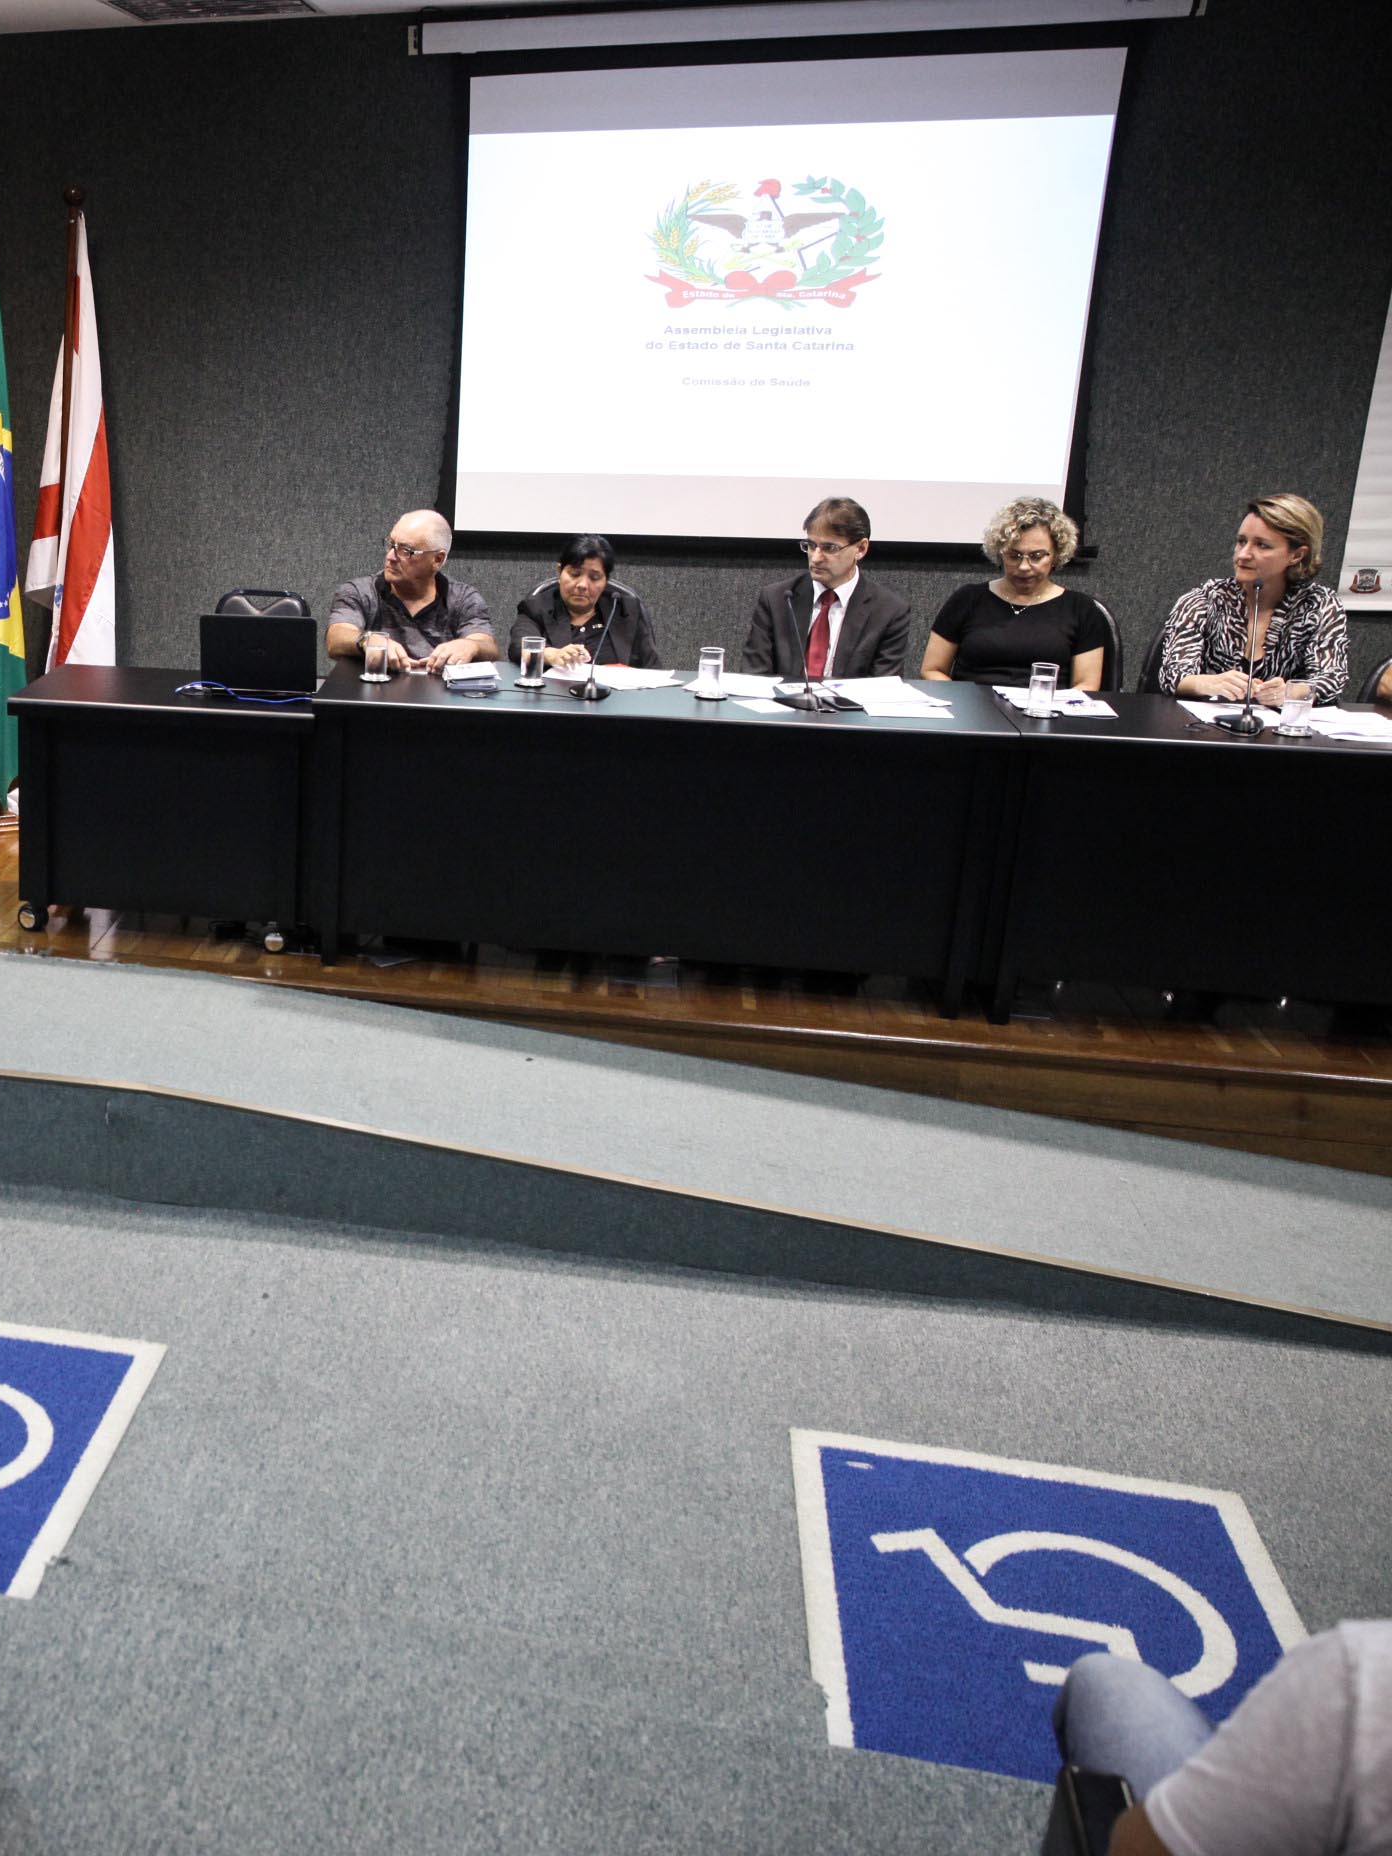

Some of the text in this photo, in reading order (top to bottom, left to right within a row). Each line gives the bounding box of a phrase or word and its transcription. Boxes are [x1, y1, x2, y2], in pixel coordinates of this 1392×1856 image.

[664, 325, 833, 337] Assembleia Legislativa
[645, 341, 855, 351] do Estado de Santa Catarina
[681, 376, 811, 387] Comissão de Saúde
